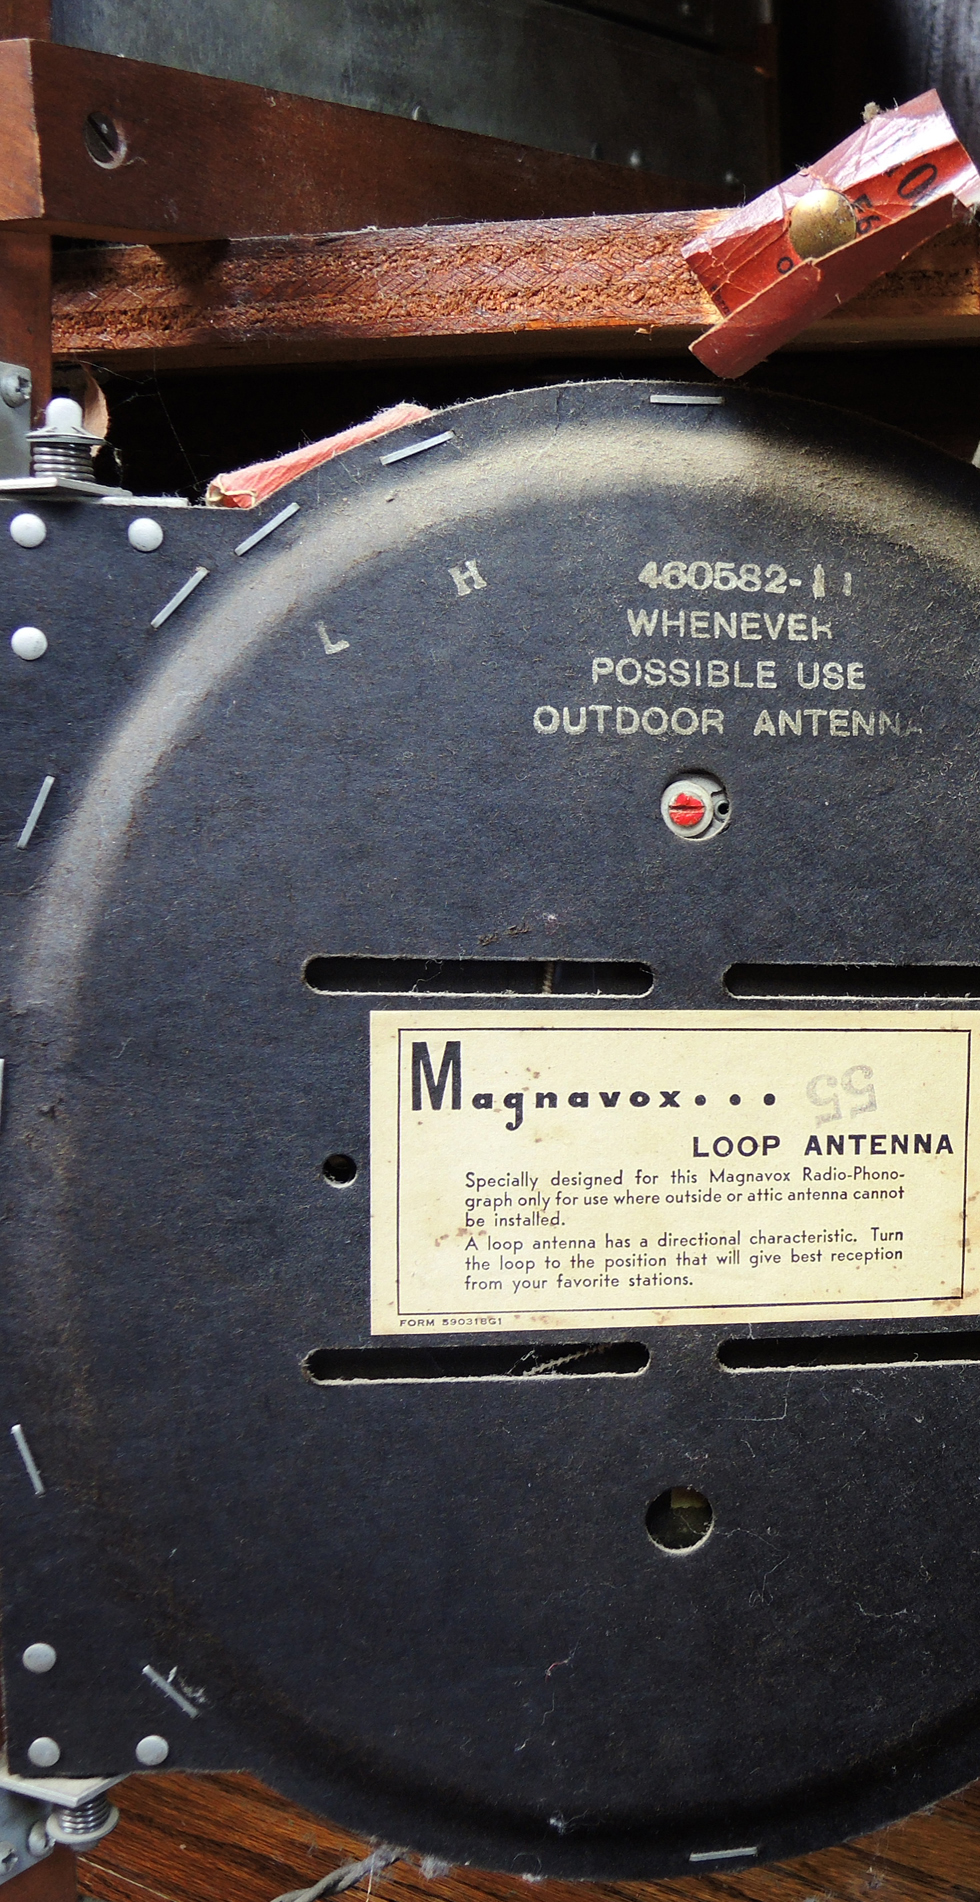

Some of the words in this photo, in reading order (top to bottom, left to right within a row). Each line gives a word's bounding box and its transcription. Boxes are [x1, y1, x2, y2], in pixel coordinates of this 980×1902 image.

[448, 560, 487, 598] H
[315, 620, 350, 656] L
[626, 608, 834, 642] WHENEVER
[591, 656, 778, 690] POSSIBLE
[796, 660, 867, 691] USE
[532, 704, 725, 737] OUTDOOR
[692, 1135, 781, 1158] LOOP
[804, 1133, 954, 1156] ANTENNA
[465, 1171, 539, 1190] Specially
[550, 1169, 623, 1190] designed
[634, 1168, 659, 1185] for
[670, 1168, 698, 1184] this
[709, 1168, 791, 1187] Magnavox
[802, 1165, 905, 1182] Radio-Phono-
[465, 1191, 512, 1212] graph
[517, 1191, 551, 1212] only
[555, 1190, 579, 1206] for
[583, 1195, 609, 1206] use
[613, 1189, 660, 1205] where
[665, 1187, 722, 1204] outside
[726, 1193, 743, 1202] or
[747, 1187, 783, 1202] attic
[787, 1187, 848, 1201] antenna
[853, 1185, 905, 1200] cannot
[465, 1211, 485, 1228] be
[494, 1210, 565, 1227] installed.
[464, 1236, 479, 1251] A
[488, 1235, 523, 1255] loop
[532, 1236, 596, 1250] antenna
[605, 1232, 631, 1249] has
[639, 1238, 648, 1248] a
[657, 1230, 741, 1247] directional
[749, 1228, 857, 1245] characteristic.
[870, 1226, 904, 1242] Turn
[465, 1255, 490, 1271] the
[500, 1254, 535, 1274] loop
[544, 1256, 561, 1269] to
[570, 1253, 595, 1269] the
[605, 1252, 667, 1272] position
[675, 1251, 708, 1266] that
[716, 1249, 740, 1265] will
[749, 1249, 781, 1269] give
[791, 1247, 823, 1263] best
[831, 1247, 903, 1266] reception
[464, 1275, 502, 1290] from
[512, 1279, 548, 1294] your
[556, 1273, 620, 1289] favorite
[628, 1273, 693, 1287] stations.
[399, 1319, 435, 1327] FORM
